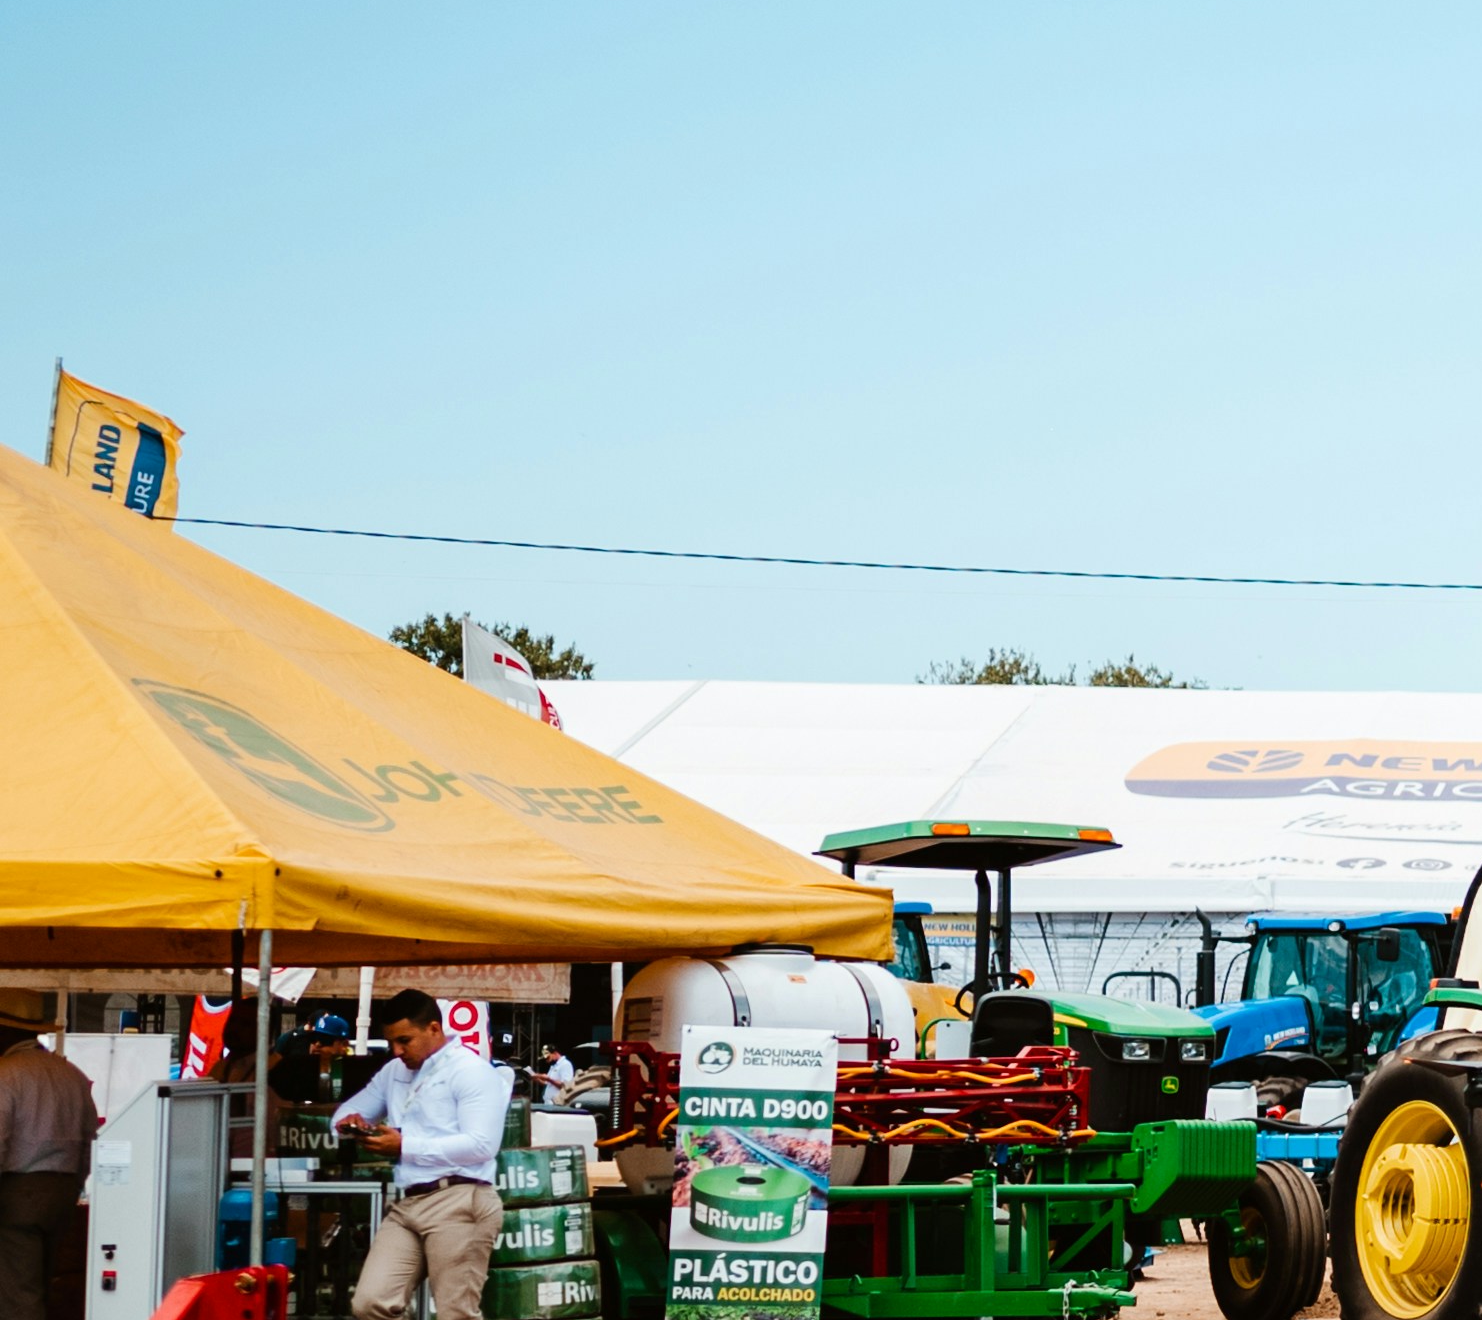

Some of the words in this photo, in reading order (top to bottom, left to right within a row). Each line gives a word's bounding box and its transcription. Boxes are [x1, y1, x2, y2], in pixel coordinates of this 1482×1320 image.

[92, 424, 121, 494] LAND
[743, 1047, 823, 1058] MAQUINARIA
[743, 1058, 768, 1067] DEL
[771, 1058, 822, 1068] HUMAYA
[684, 1096, 757, 1118] CINTA
[763, 1098, 828, 1121] D900
[708, 1206, 785, 1232] Rivulis
[674, 1252, 819, 1285] PLÁSTICO
[672, 1286, 714, 1300] PARA
[717, 1287, 816, 1302] ACOLCHADO
